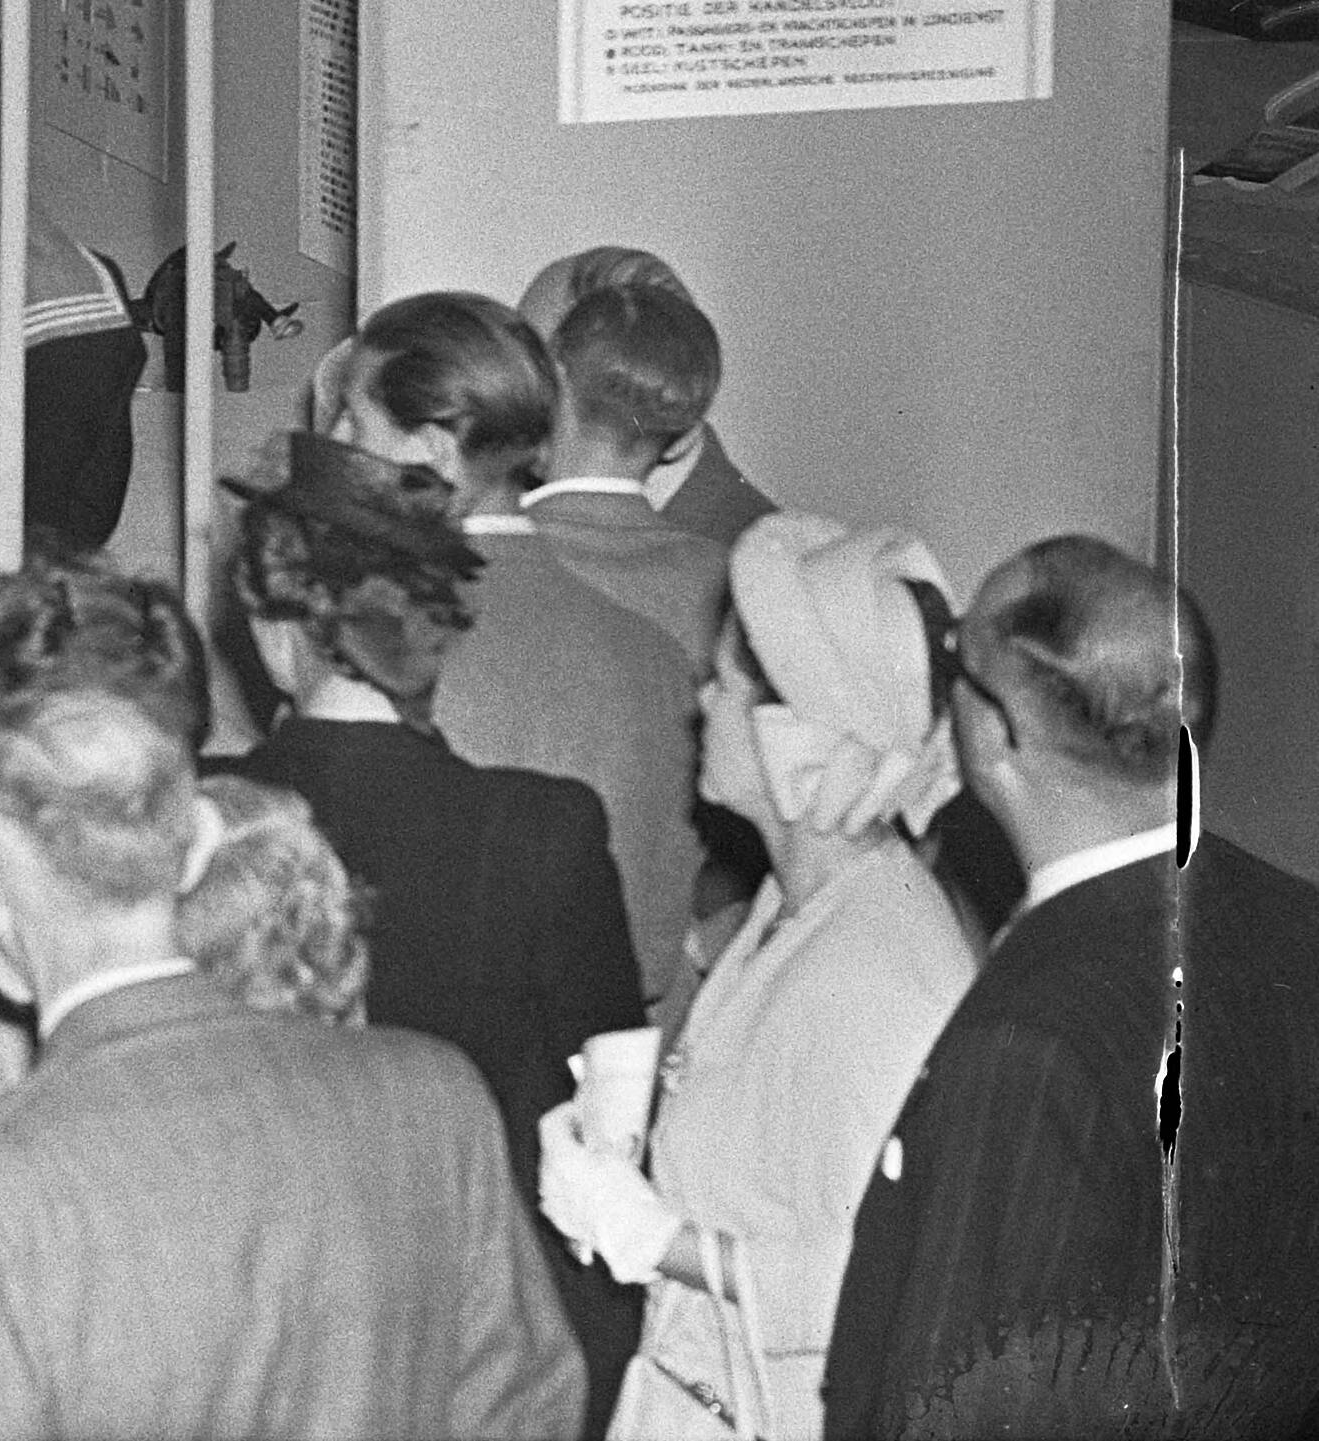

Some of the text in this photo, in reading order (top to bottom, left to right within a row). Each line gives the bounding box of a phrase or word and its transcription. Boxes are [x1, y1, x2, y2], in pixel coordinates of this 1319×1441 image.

[619, 2, 690, 20] POSITIE
[703, 0, 739, 16] DER
[738, 39, 763, 52] EN
